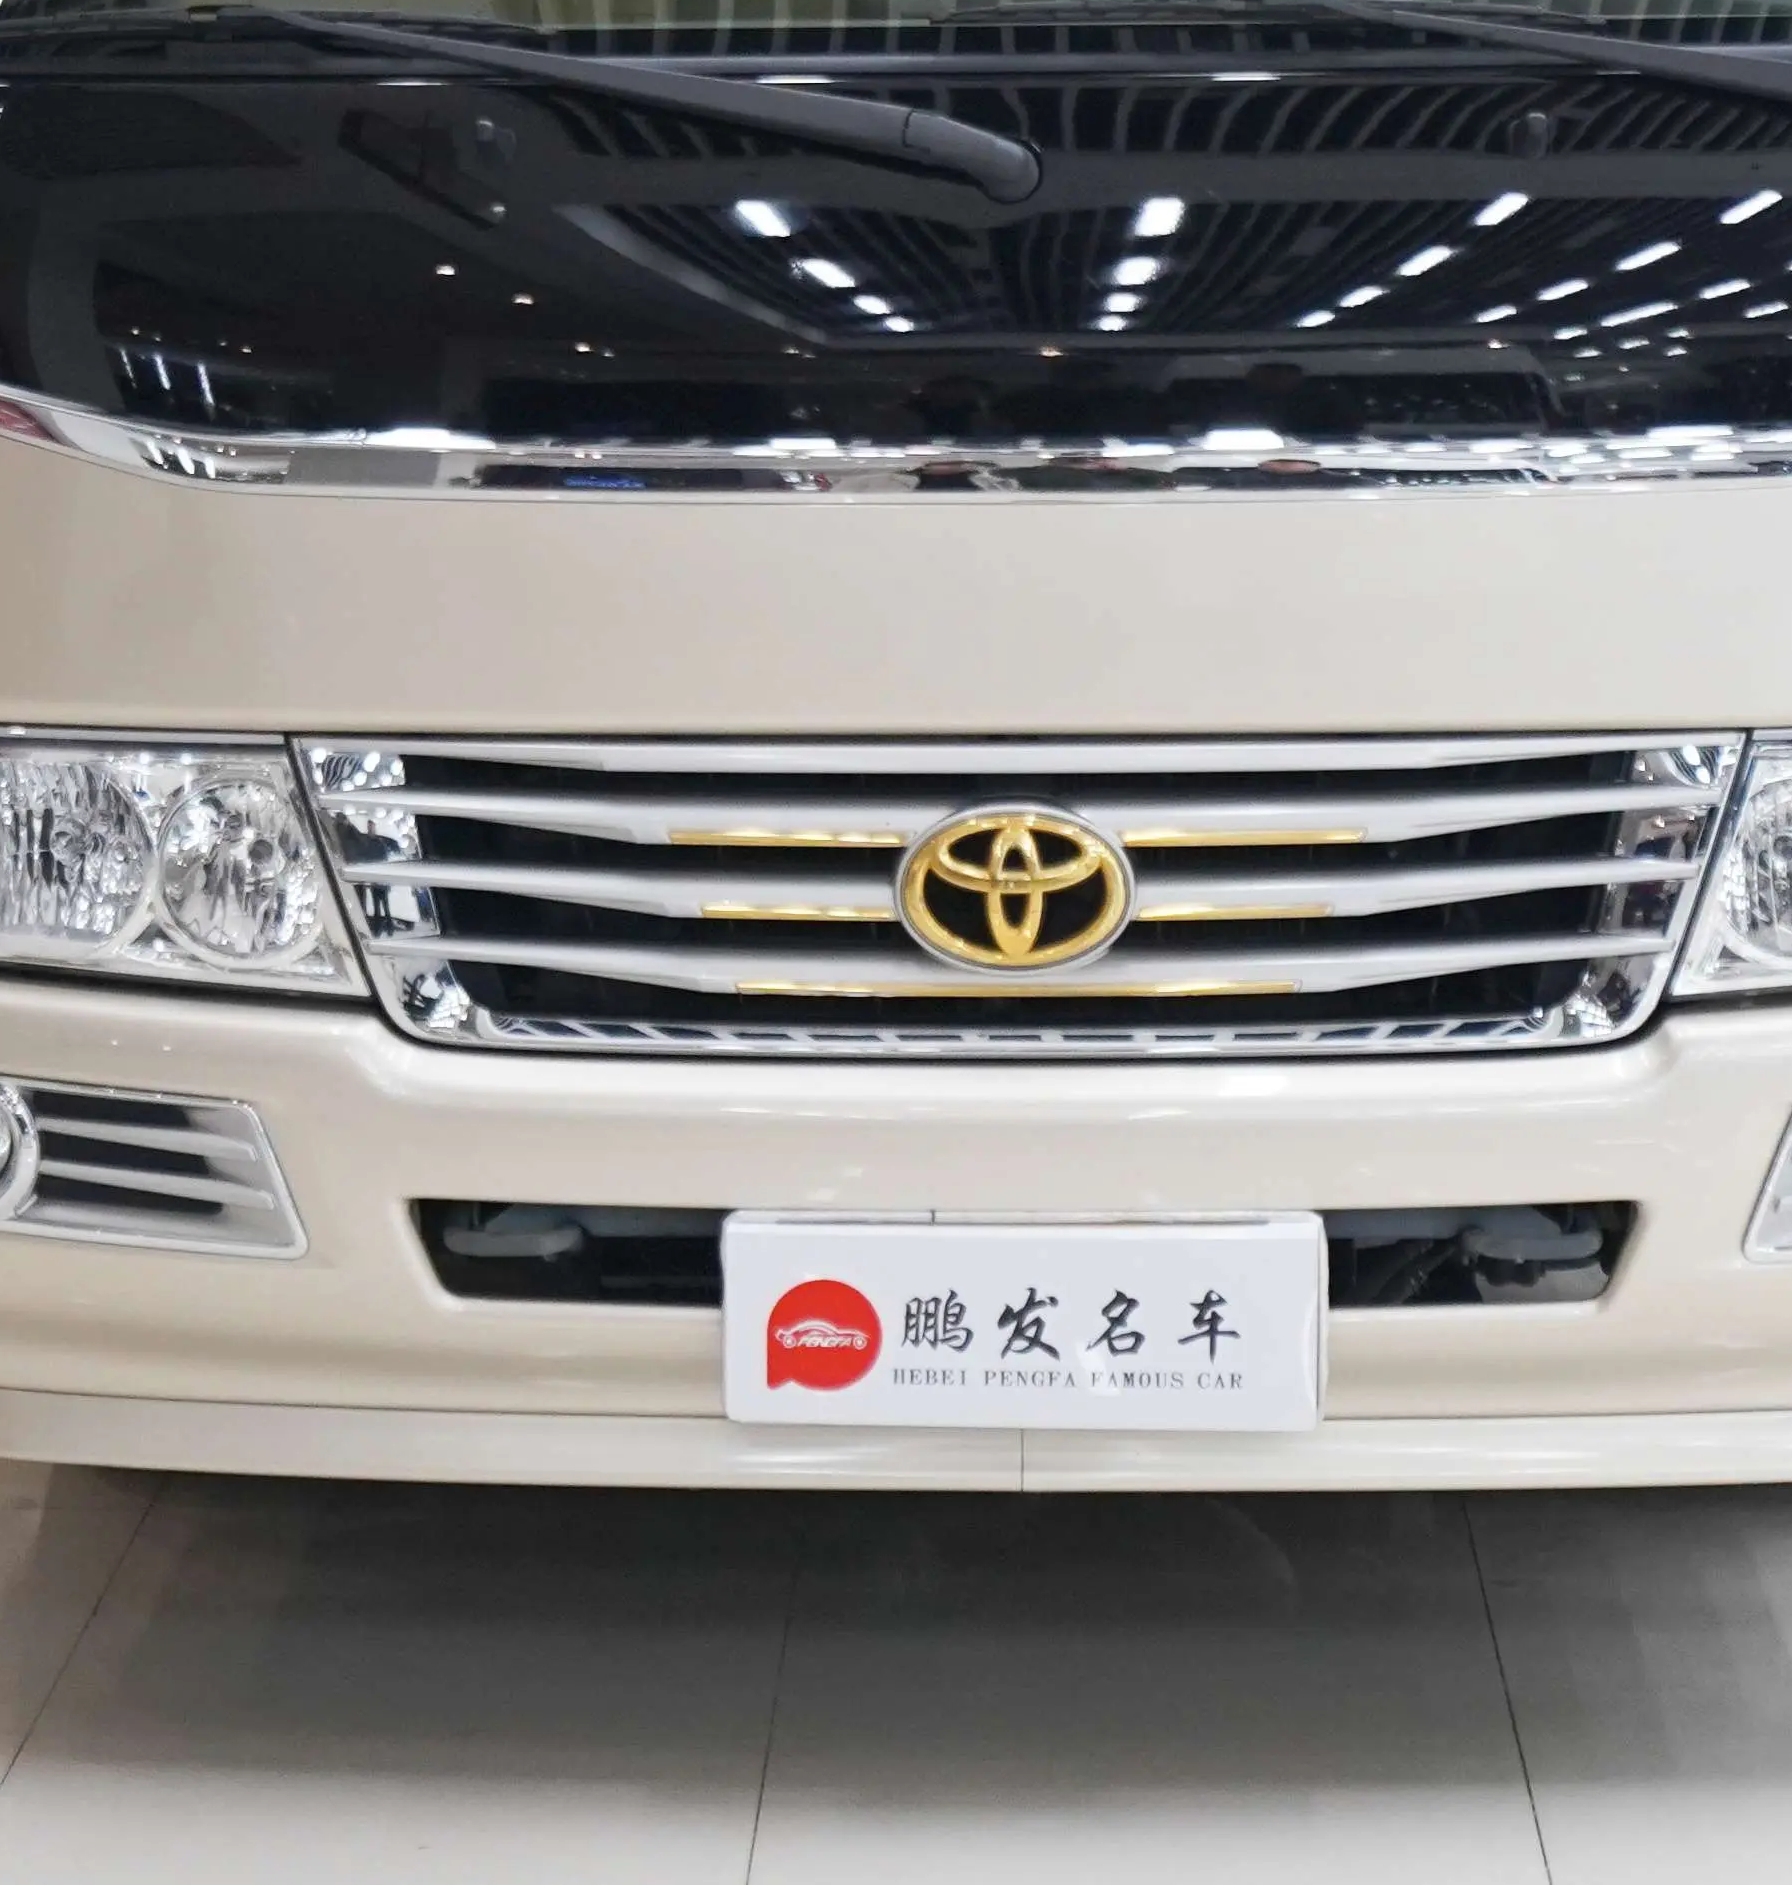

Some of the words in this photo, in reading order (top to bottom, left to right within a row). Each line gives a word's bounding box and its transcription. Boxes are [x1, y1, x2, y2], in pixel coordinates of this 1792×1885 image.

[900, 1287, 1241, 1365] 鹏发名车
[892, 1368, 968, 1387] HEBEI
[983, 1369, 1078, 1388] PENGFA
[1090, 1370, 1185, 1389] FAMOUS
[1197, 1371, 1244, 1390] CAR
